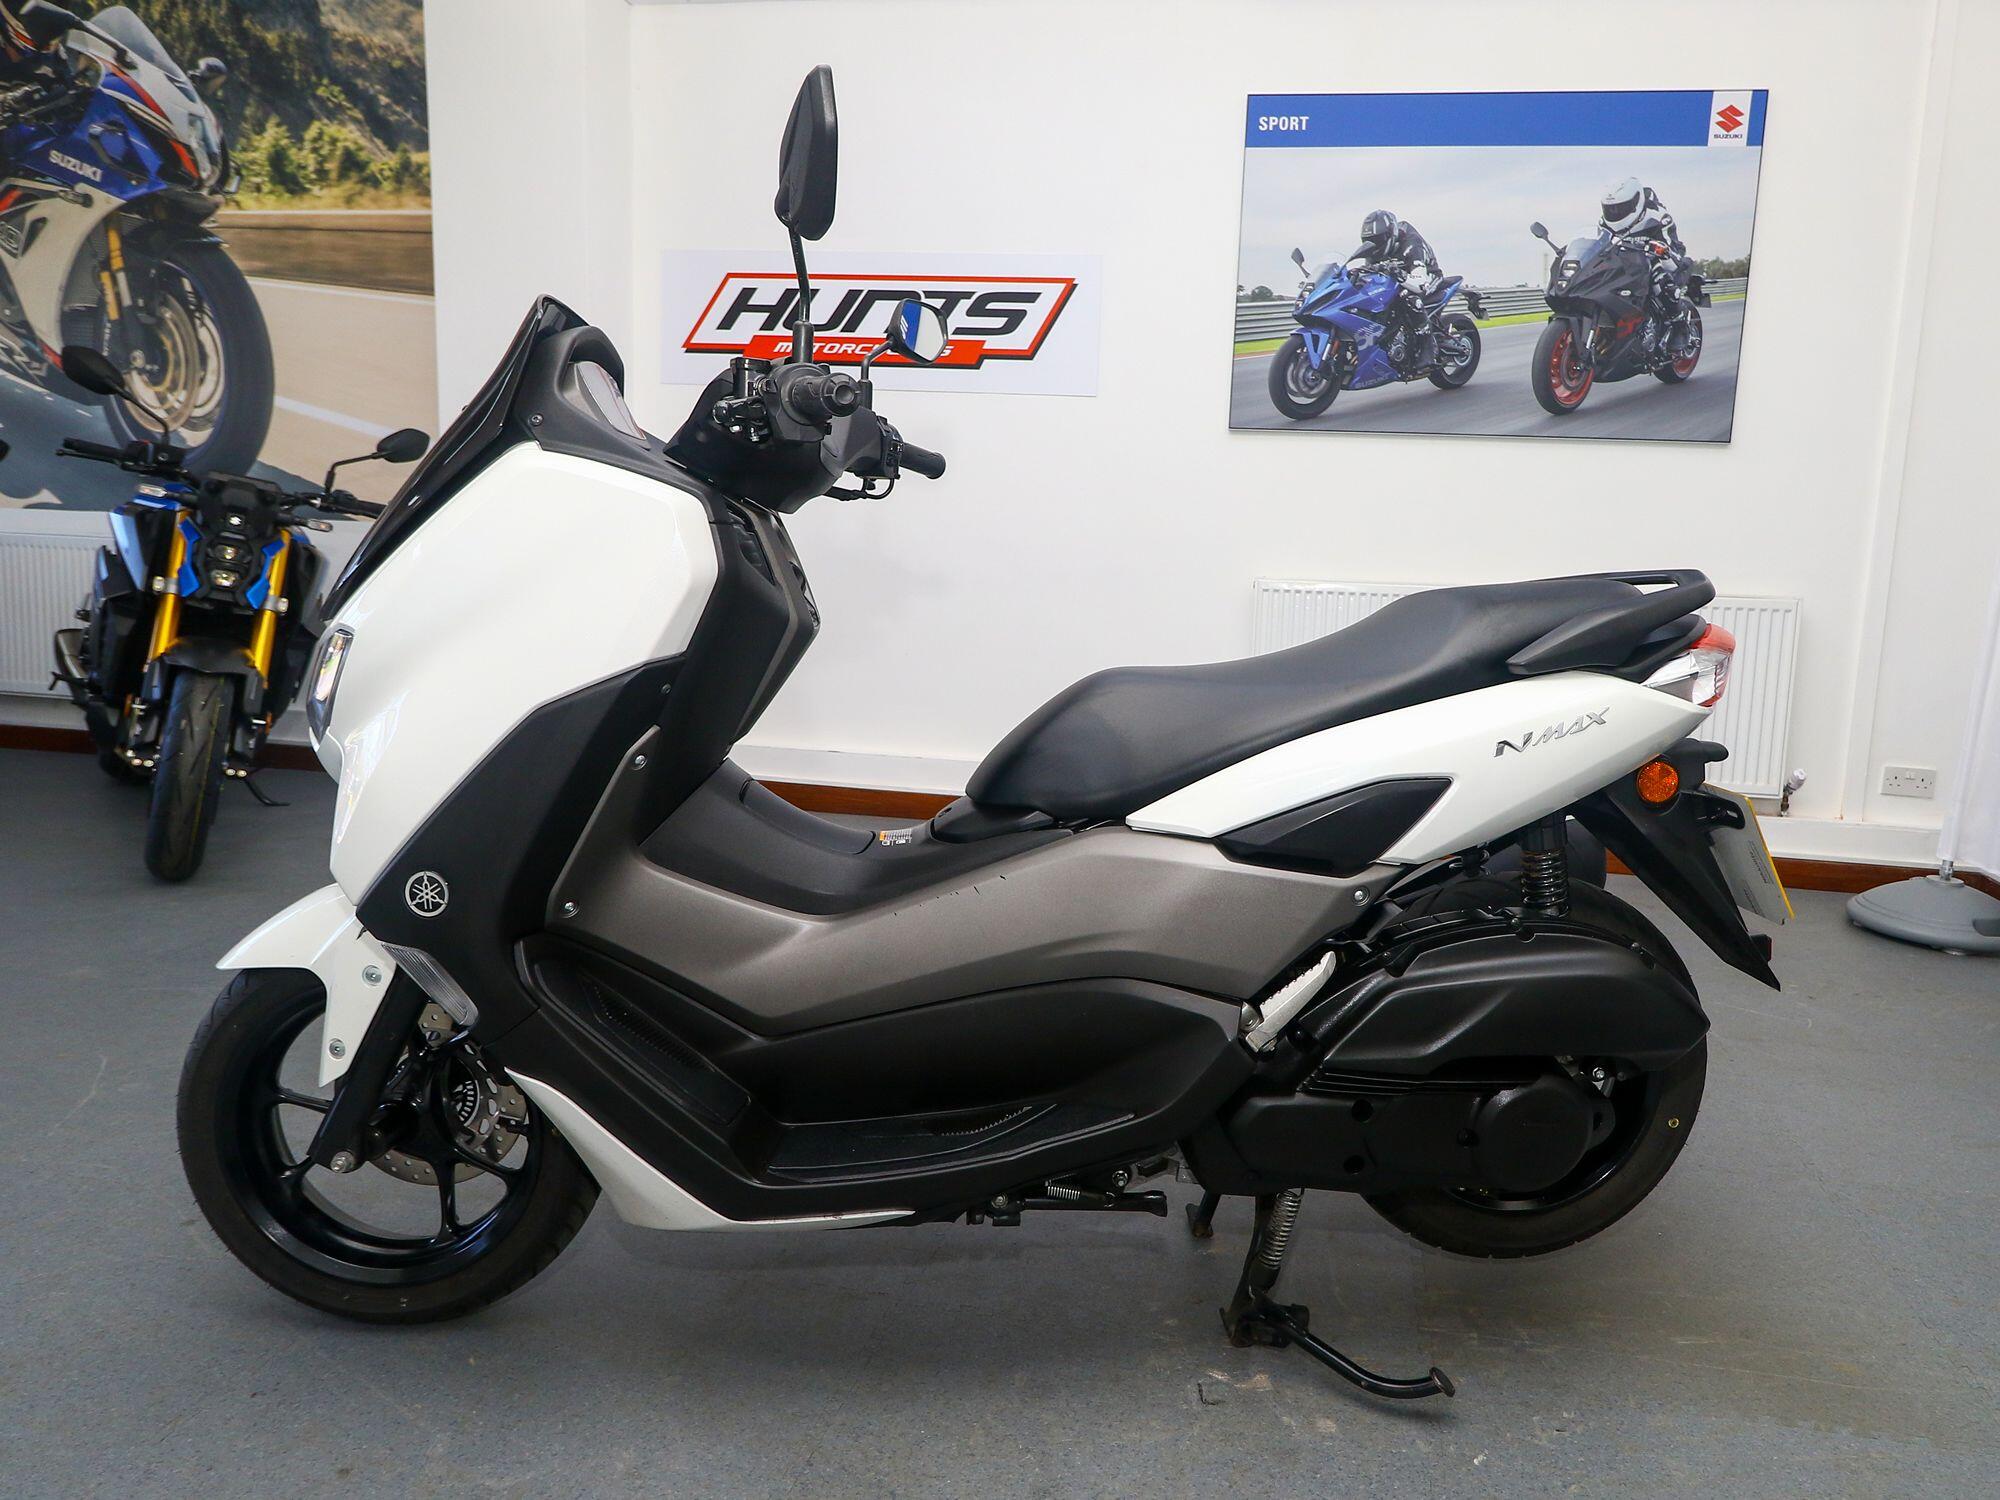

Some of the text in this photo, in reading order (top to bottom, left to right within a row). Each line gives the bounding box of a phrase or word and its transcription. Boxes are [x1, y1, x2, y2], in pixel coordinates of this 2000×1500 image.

[1258, 116, 1310, 131] SPORT
[48, 150, 103, 183] SUZUKI
[716, 286, 1043, 336] HUNTS
[773, 342, 955, 357] MTORCS
[1494, 706, 1610, 758] NMAX
